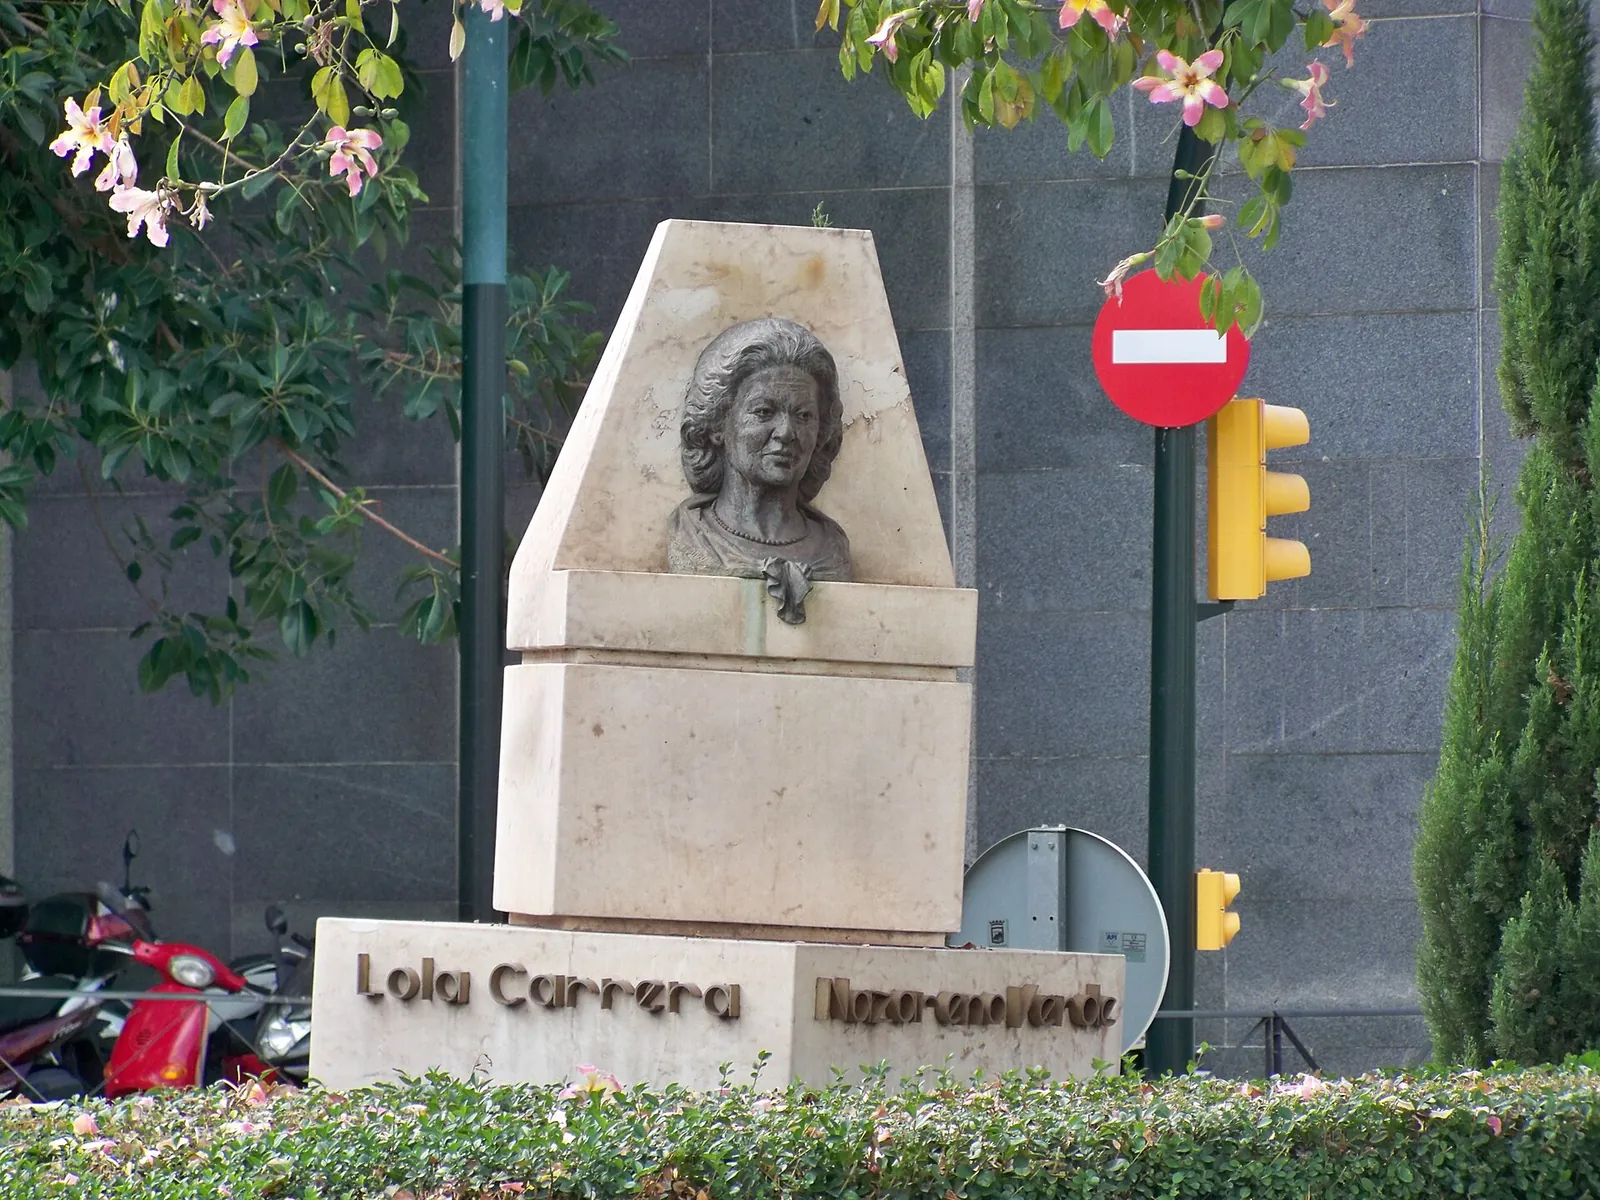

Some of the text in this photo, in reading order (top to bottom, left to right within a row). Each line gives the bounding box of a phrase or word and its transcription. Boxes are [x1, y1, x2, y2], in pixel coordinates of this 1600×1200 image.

[356, 953, 740, 1017] Lola Carrera
[815, 977, 1005, 1026] Nazareno
